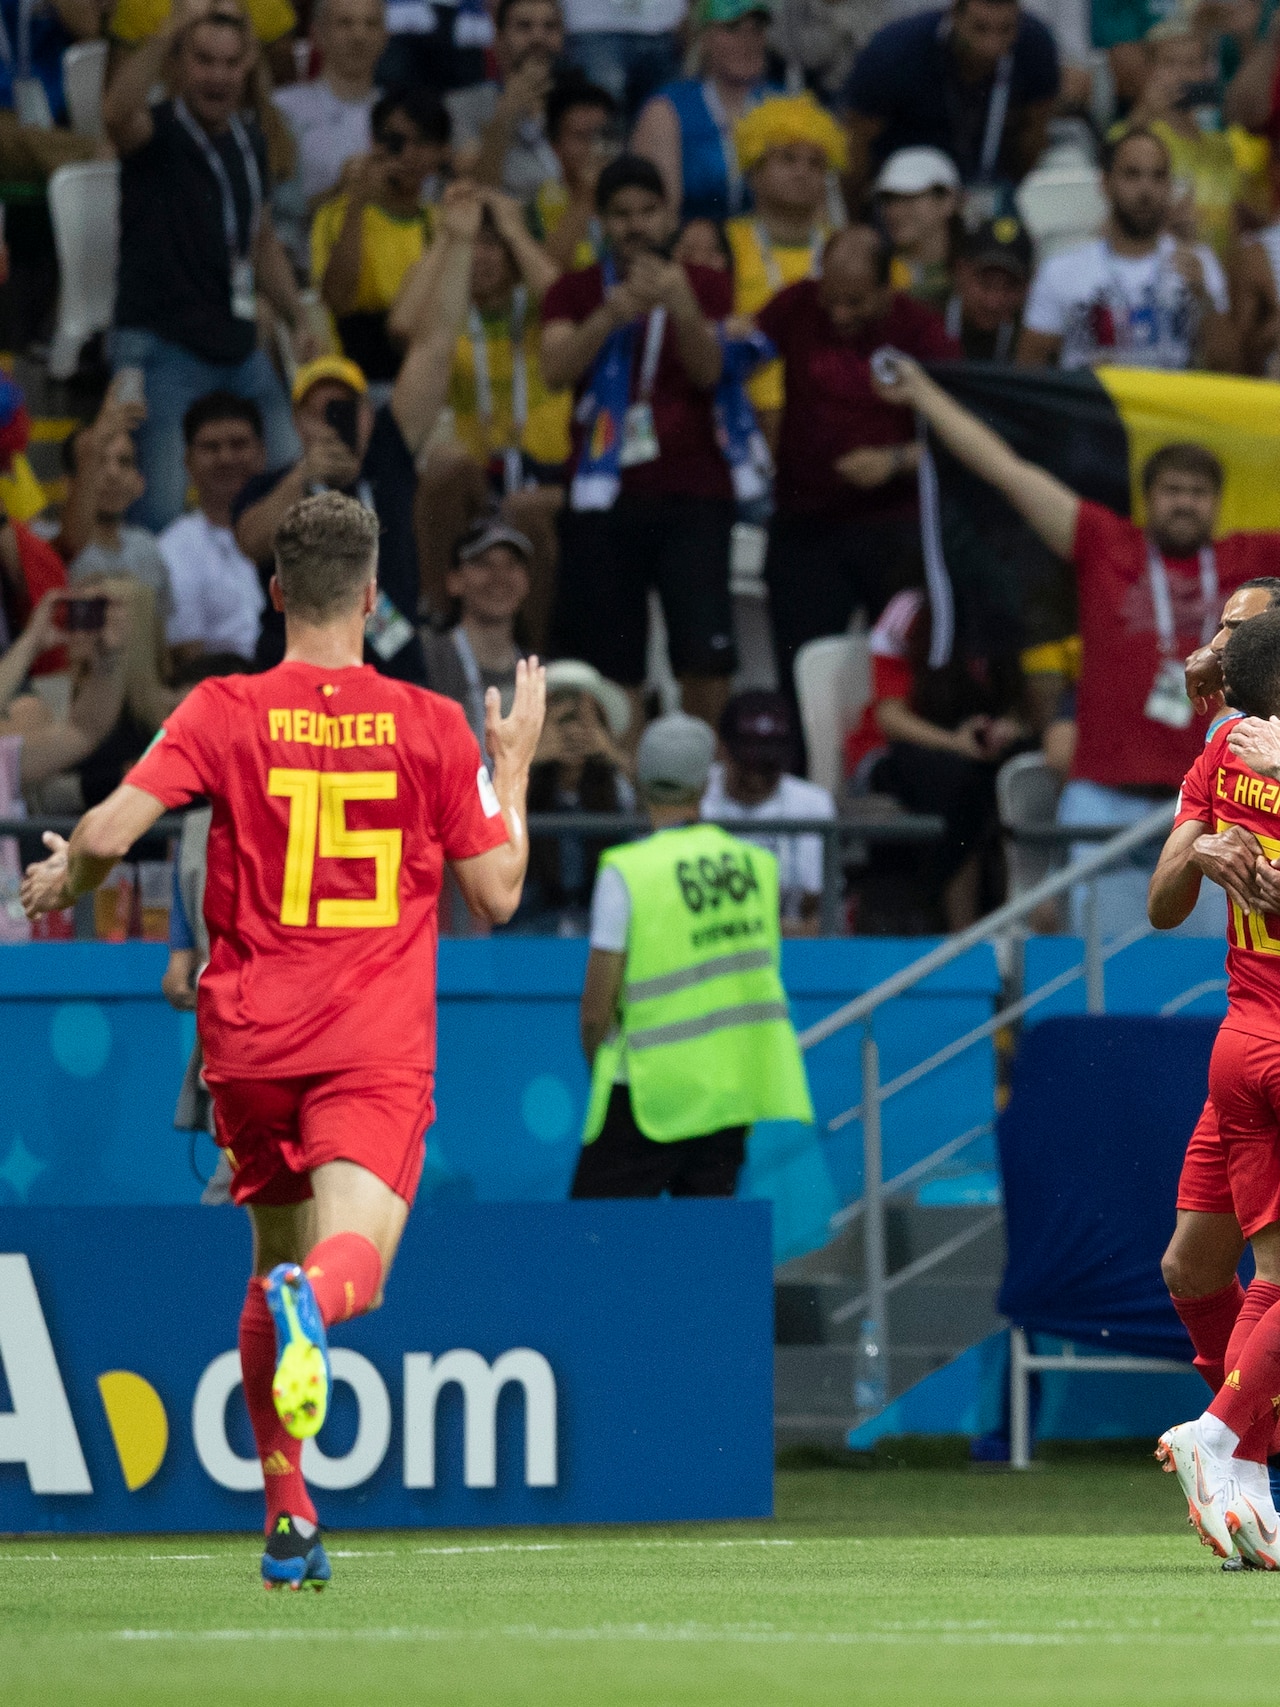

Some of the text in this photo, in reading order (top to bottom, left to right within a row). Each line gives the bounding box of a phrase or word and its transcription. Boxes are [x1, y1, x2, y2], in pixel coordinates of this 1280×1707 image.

[268, 708, 396, 749] MEUNIER
[1216, 767, 1228, 799] E.
[267, 767, 402, 928] 15
